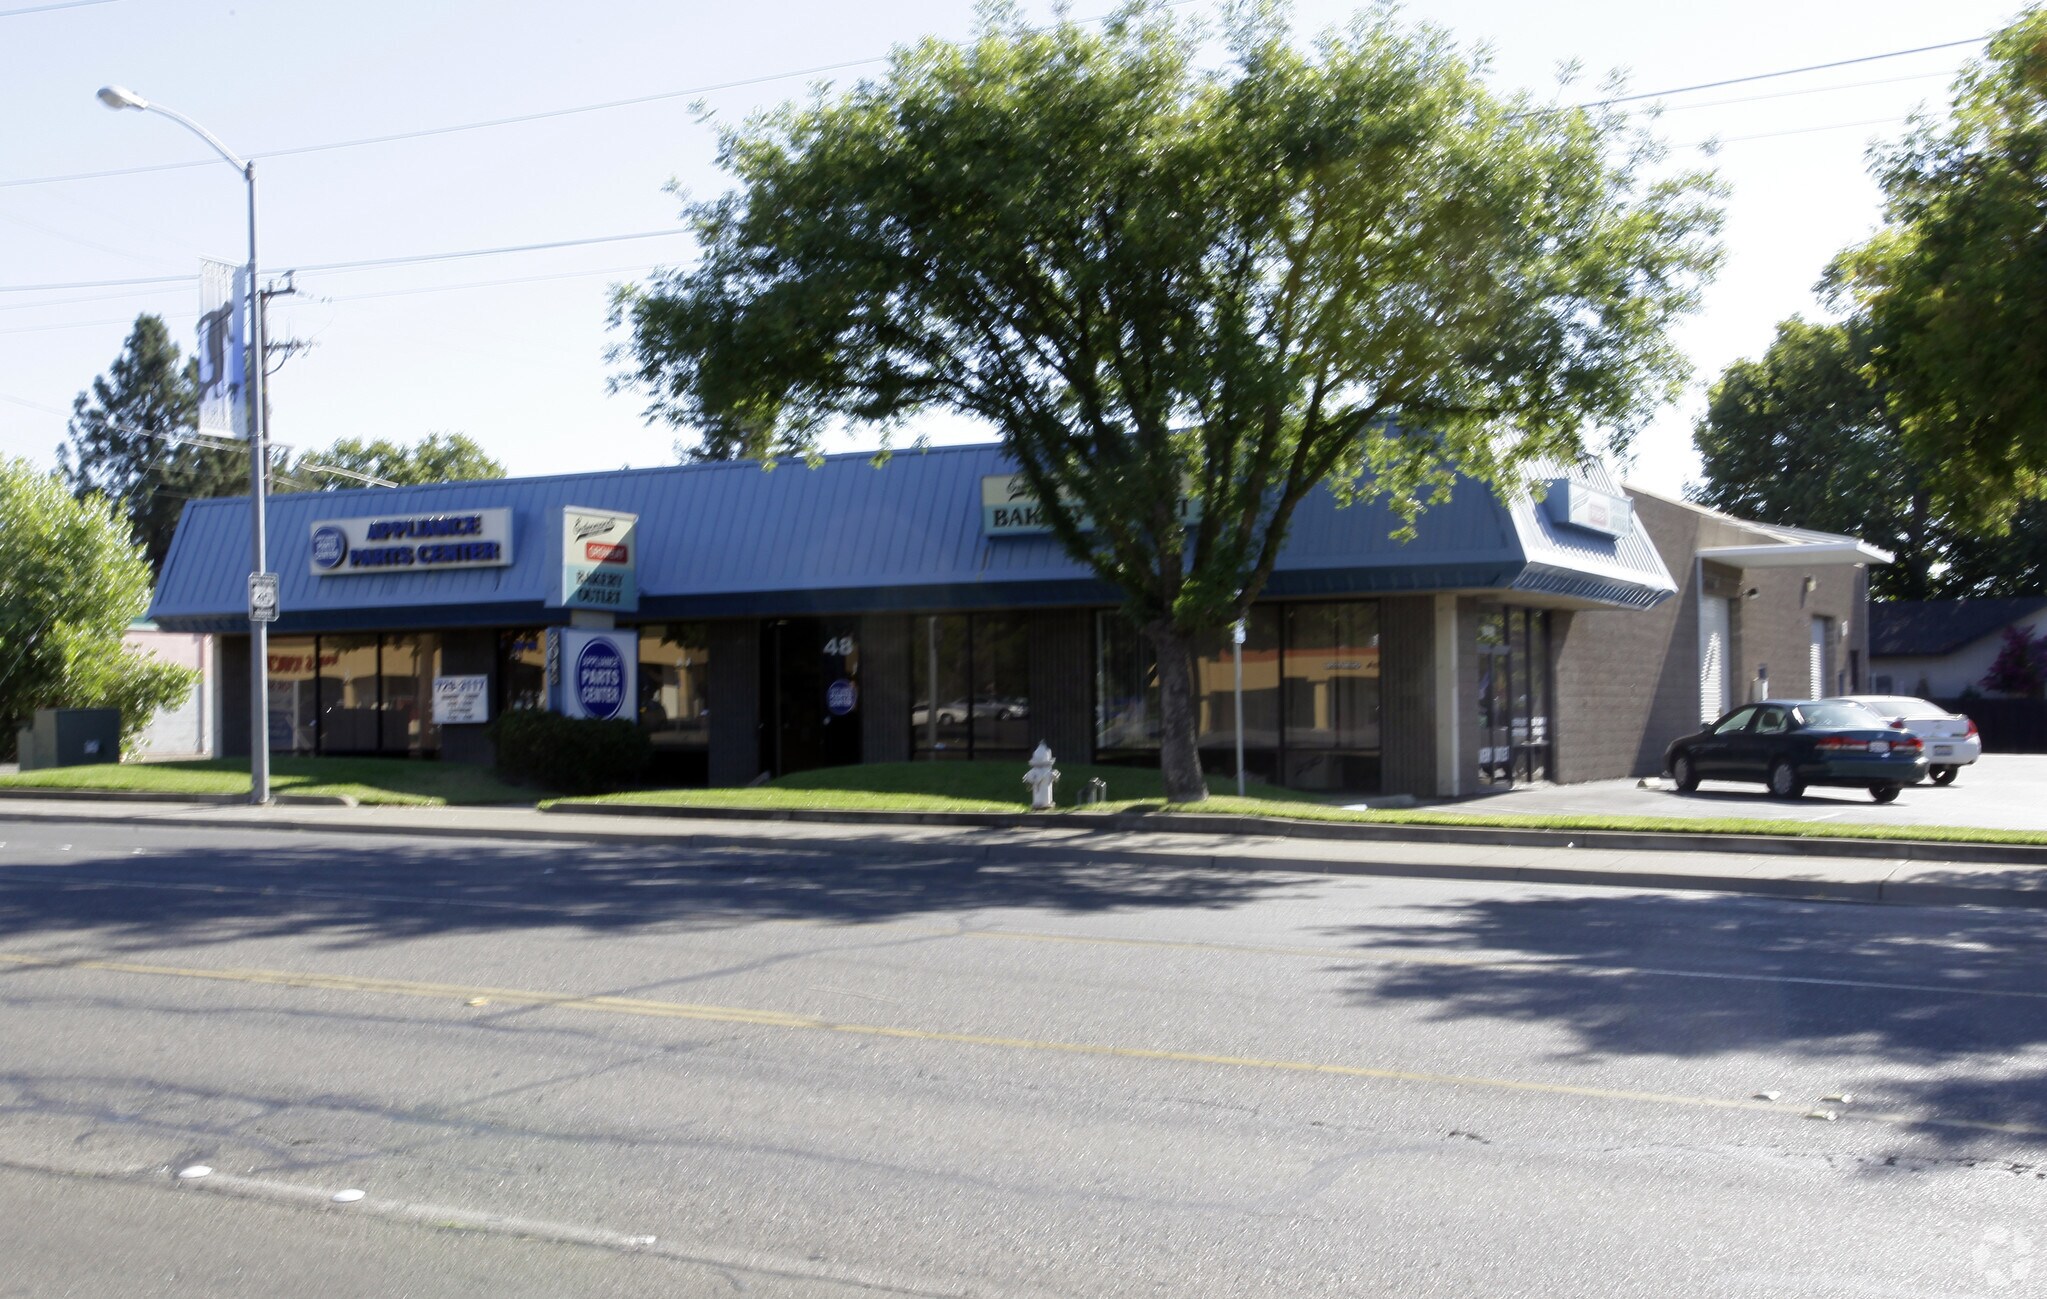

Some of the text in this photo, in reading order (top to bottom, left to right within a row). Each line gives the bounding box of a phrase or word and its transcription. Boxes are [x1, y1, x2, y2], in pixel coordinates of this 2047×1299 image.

[367, 515, 482, 541] APPLIANCE
[351, 541, 501, 567] PARTS CENTER
[576, 570, 624, 587] BAKERY
[577, 588, 622, 605] OUTLET
[823, 636, 853, 655] 48
[581, 655, 619, 667] APPLIANCE
[581, 669, 620, 685] PARTS
[581, 687, 620, 703] CENTER
